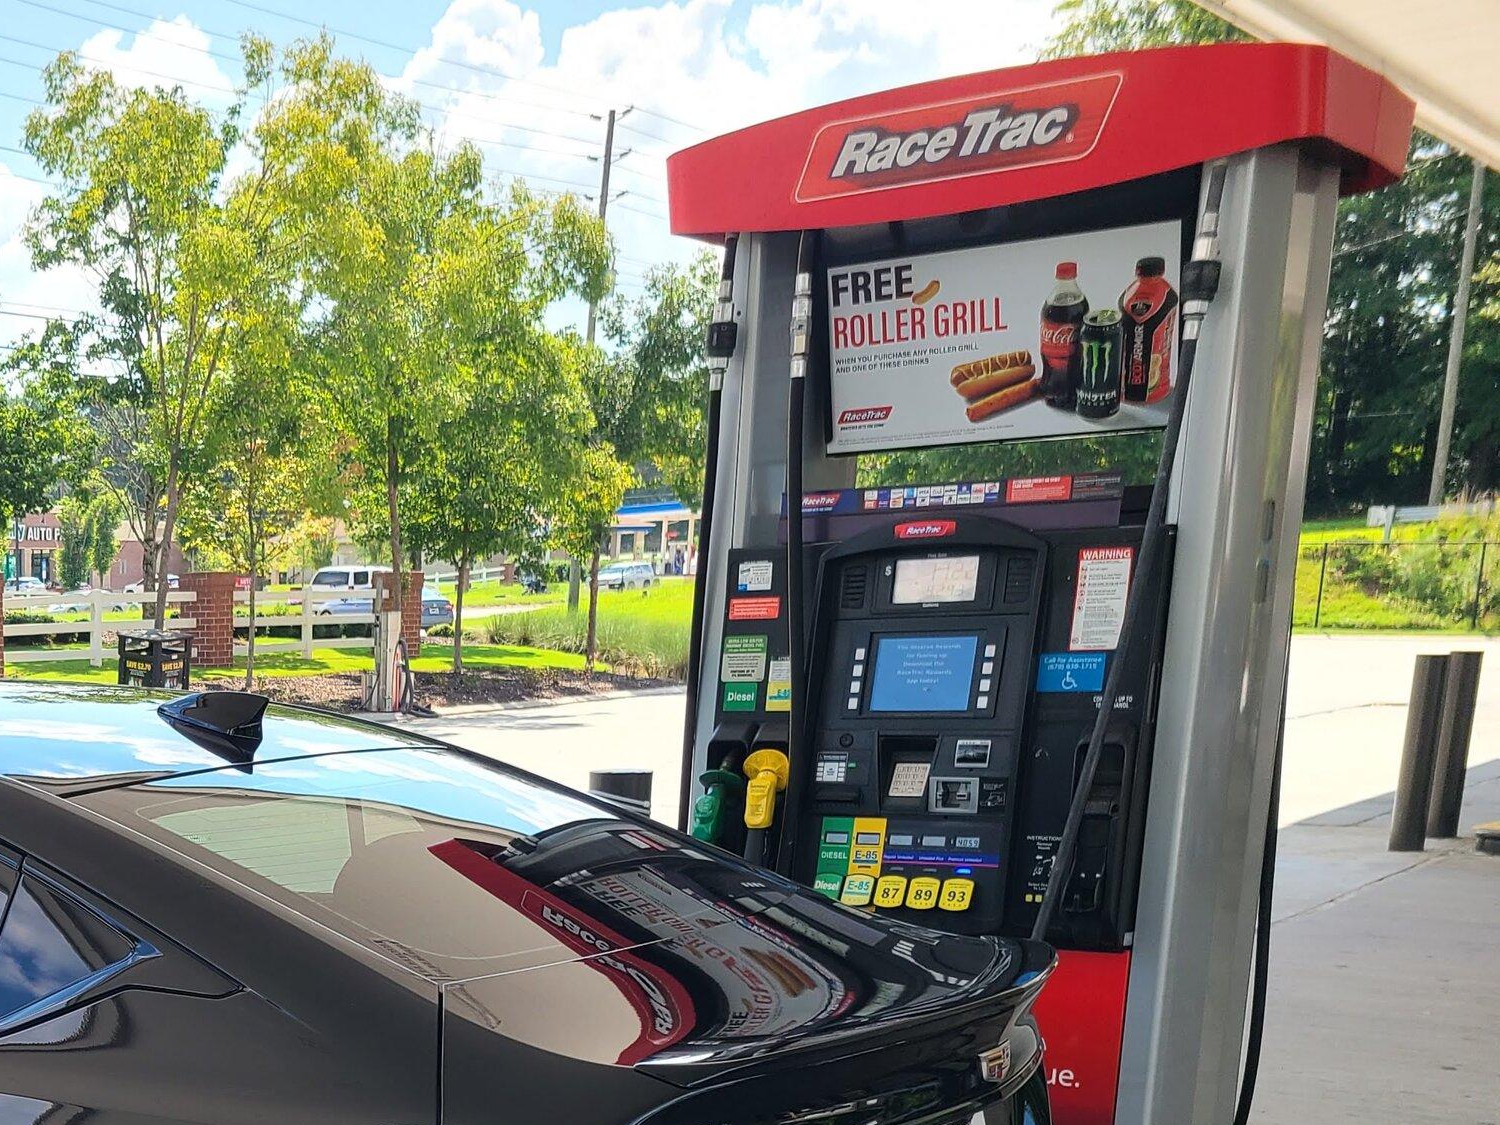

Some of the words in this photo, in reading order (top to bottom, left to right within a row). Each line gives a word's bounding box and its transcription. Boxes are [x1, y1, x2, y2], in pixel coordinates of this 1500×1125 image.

[831, 107, 1068, 178] RaceTrac
[832, 264, 913, 307] FREE
[834, 308, 926, 349] ROLLER
[934, 297, 1008, 338] GRILL
[835, 357, 856, 366] WHEN
[857, 355, 873, 364] YOU
[873, 351, 911, 361] PURCHASE
[912, 349, 928, 357] ANY
[929, 346, 957, 355] ROLLER
[958, 342, 979, 352] GRILL
[835, 366, 851, 374] AND
[851, 365, 866, 373] ONE
[868, 363, 877, 371] OF
[879, 360, 901, 369] THESE
[902, 358, 929, 367] DRINKS
[843, 409, 888, 422] RaceTrac
[27, 527, 52, 541] AUTO
[906, 524, 942, 535] RaceTrac
[1082, 549, 1131, 560] WARNING
[727, 691, 755, 702] Diesel
[821, 851, 848, 859] DIESEL
[855, 850, 878, 860] E-85
[814, 880, 841, 890] Diesel
[848, 880, 870, 891] E-85
[882, 887, 900, 899] 87
[914, 889, 932, 901] 89
[947, 890, 966, 902] 93
